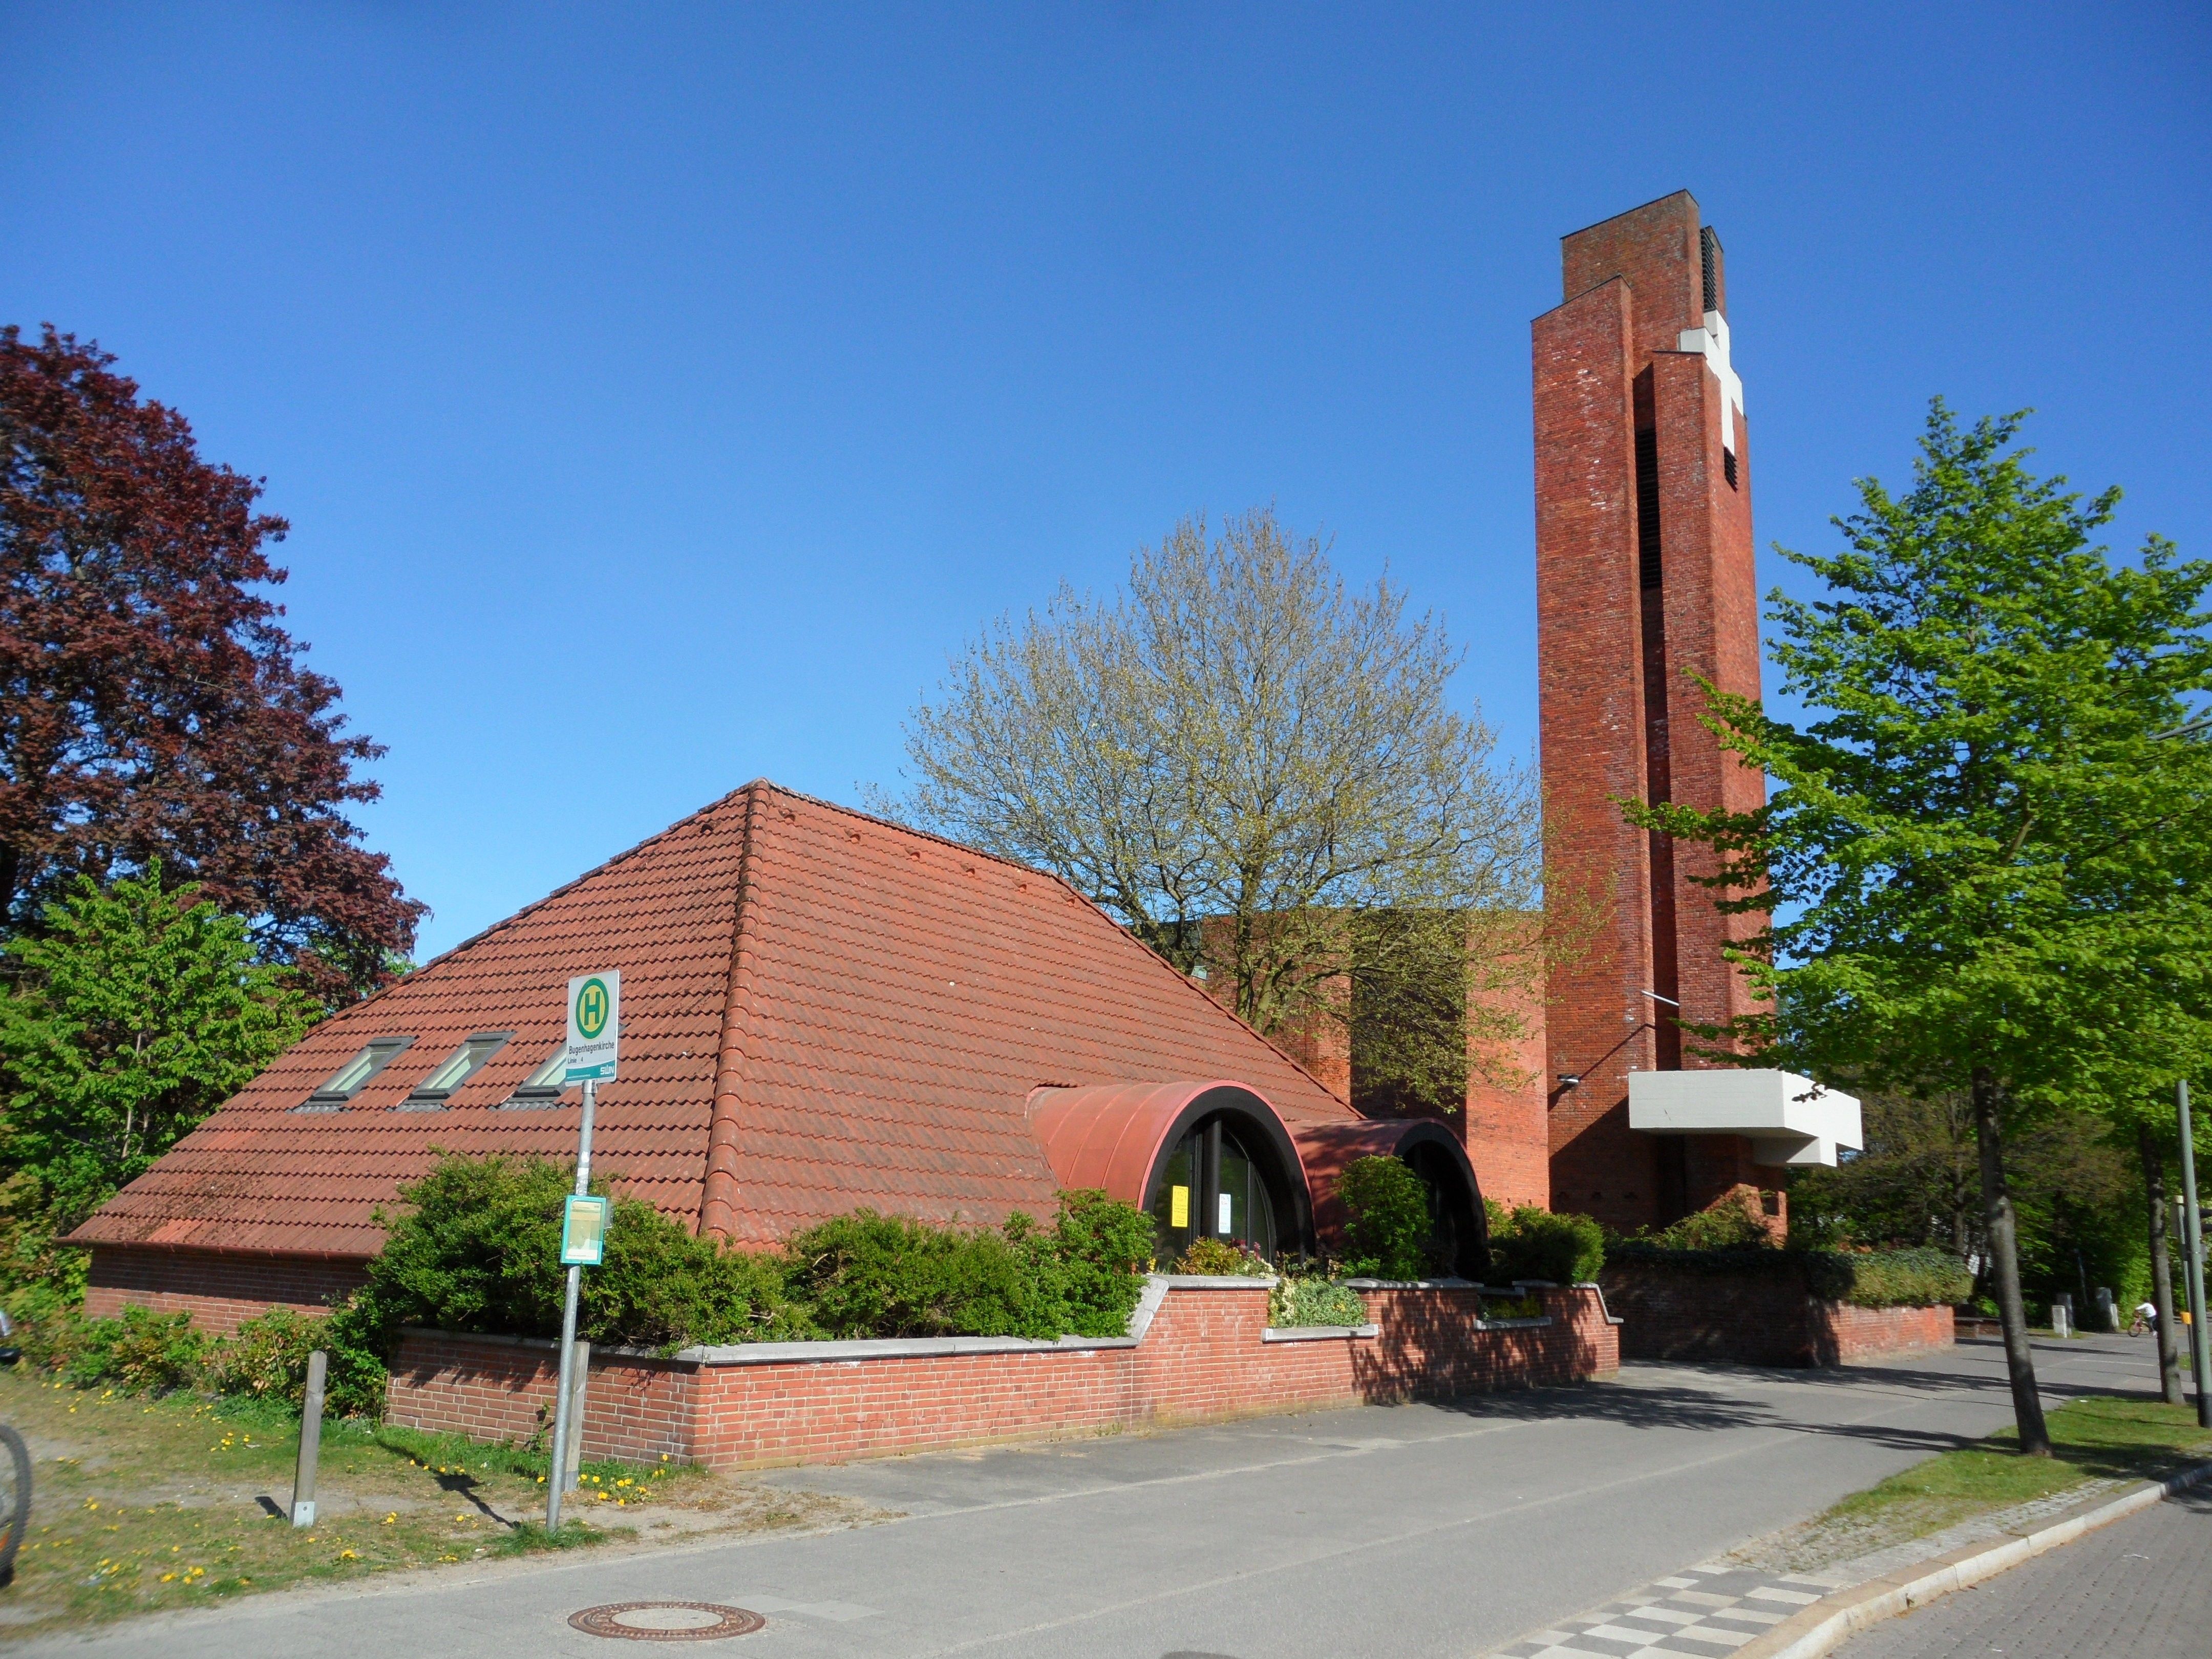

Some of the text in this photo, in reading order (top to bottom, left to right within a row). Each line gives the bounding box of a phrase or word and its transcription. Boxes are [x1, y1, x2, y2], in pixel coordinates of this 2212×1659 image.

[584, 991, 601, 1026] H
[569, 1040, 614, 1055] Bugenhagenkirche
[600, 1065, 614, 1075] SWN
